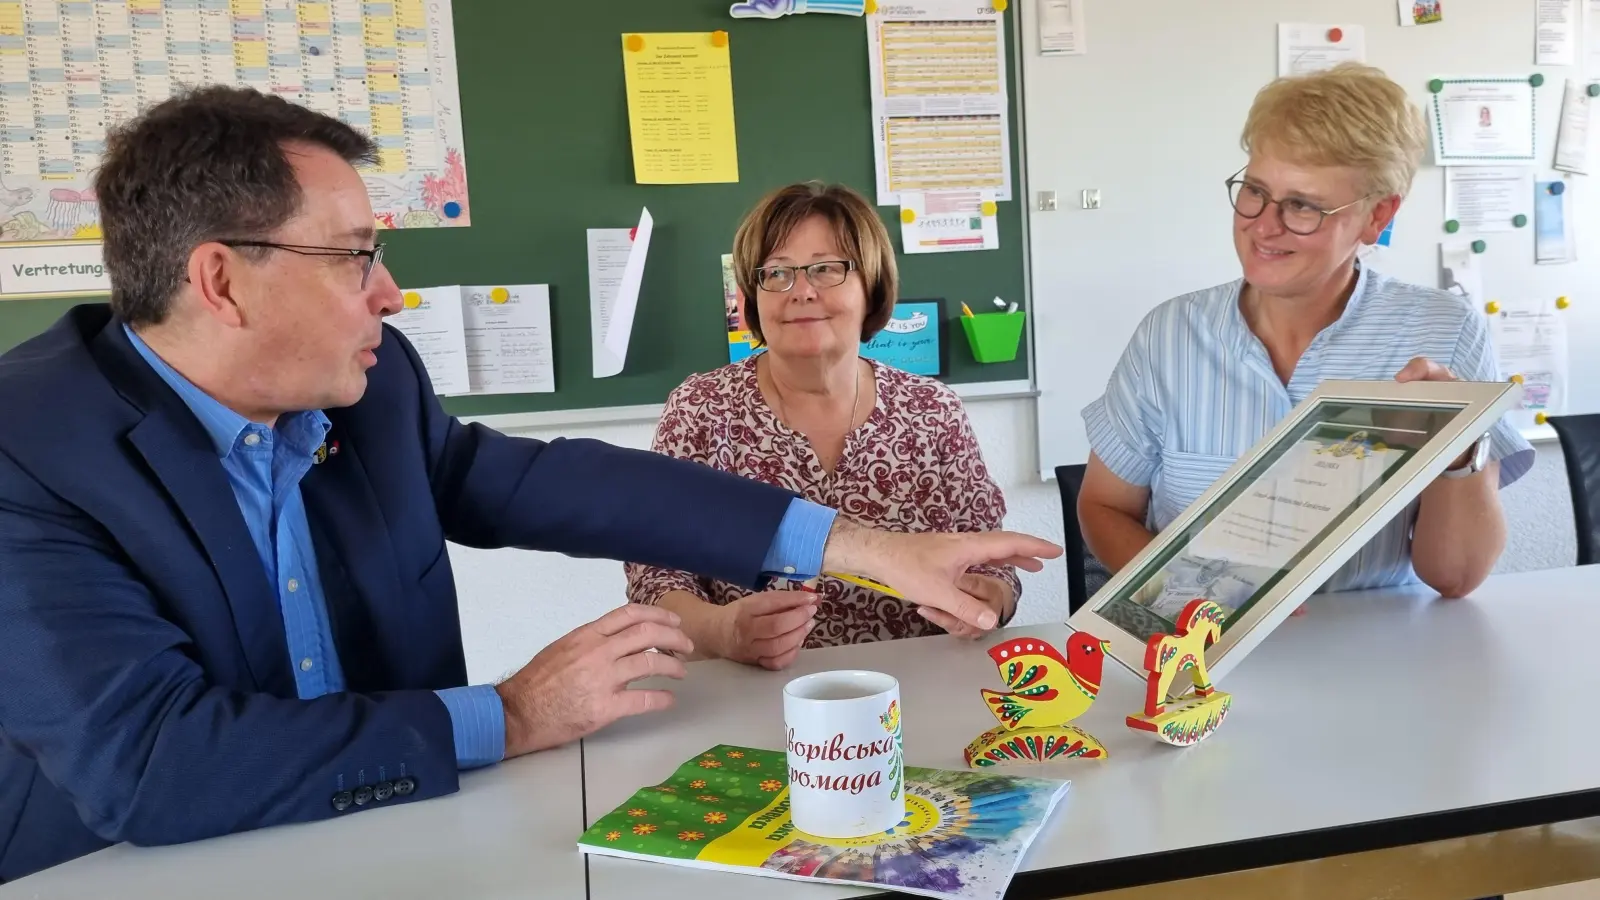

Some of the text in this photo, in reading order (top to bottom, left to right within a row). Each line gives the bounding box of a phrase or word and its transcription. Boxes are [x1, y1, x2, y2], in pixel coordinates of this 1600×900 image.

[12, 262, 106, 277] Vertretung
[783, 721, 894, 763] ворівська
[787, 763, 882, 795] ромада
